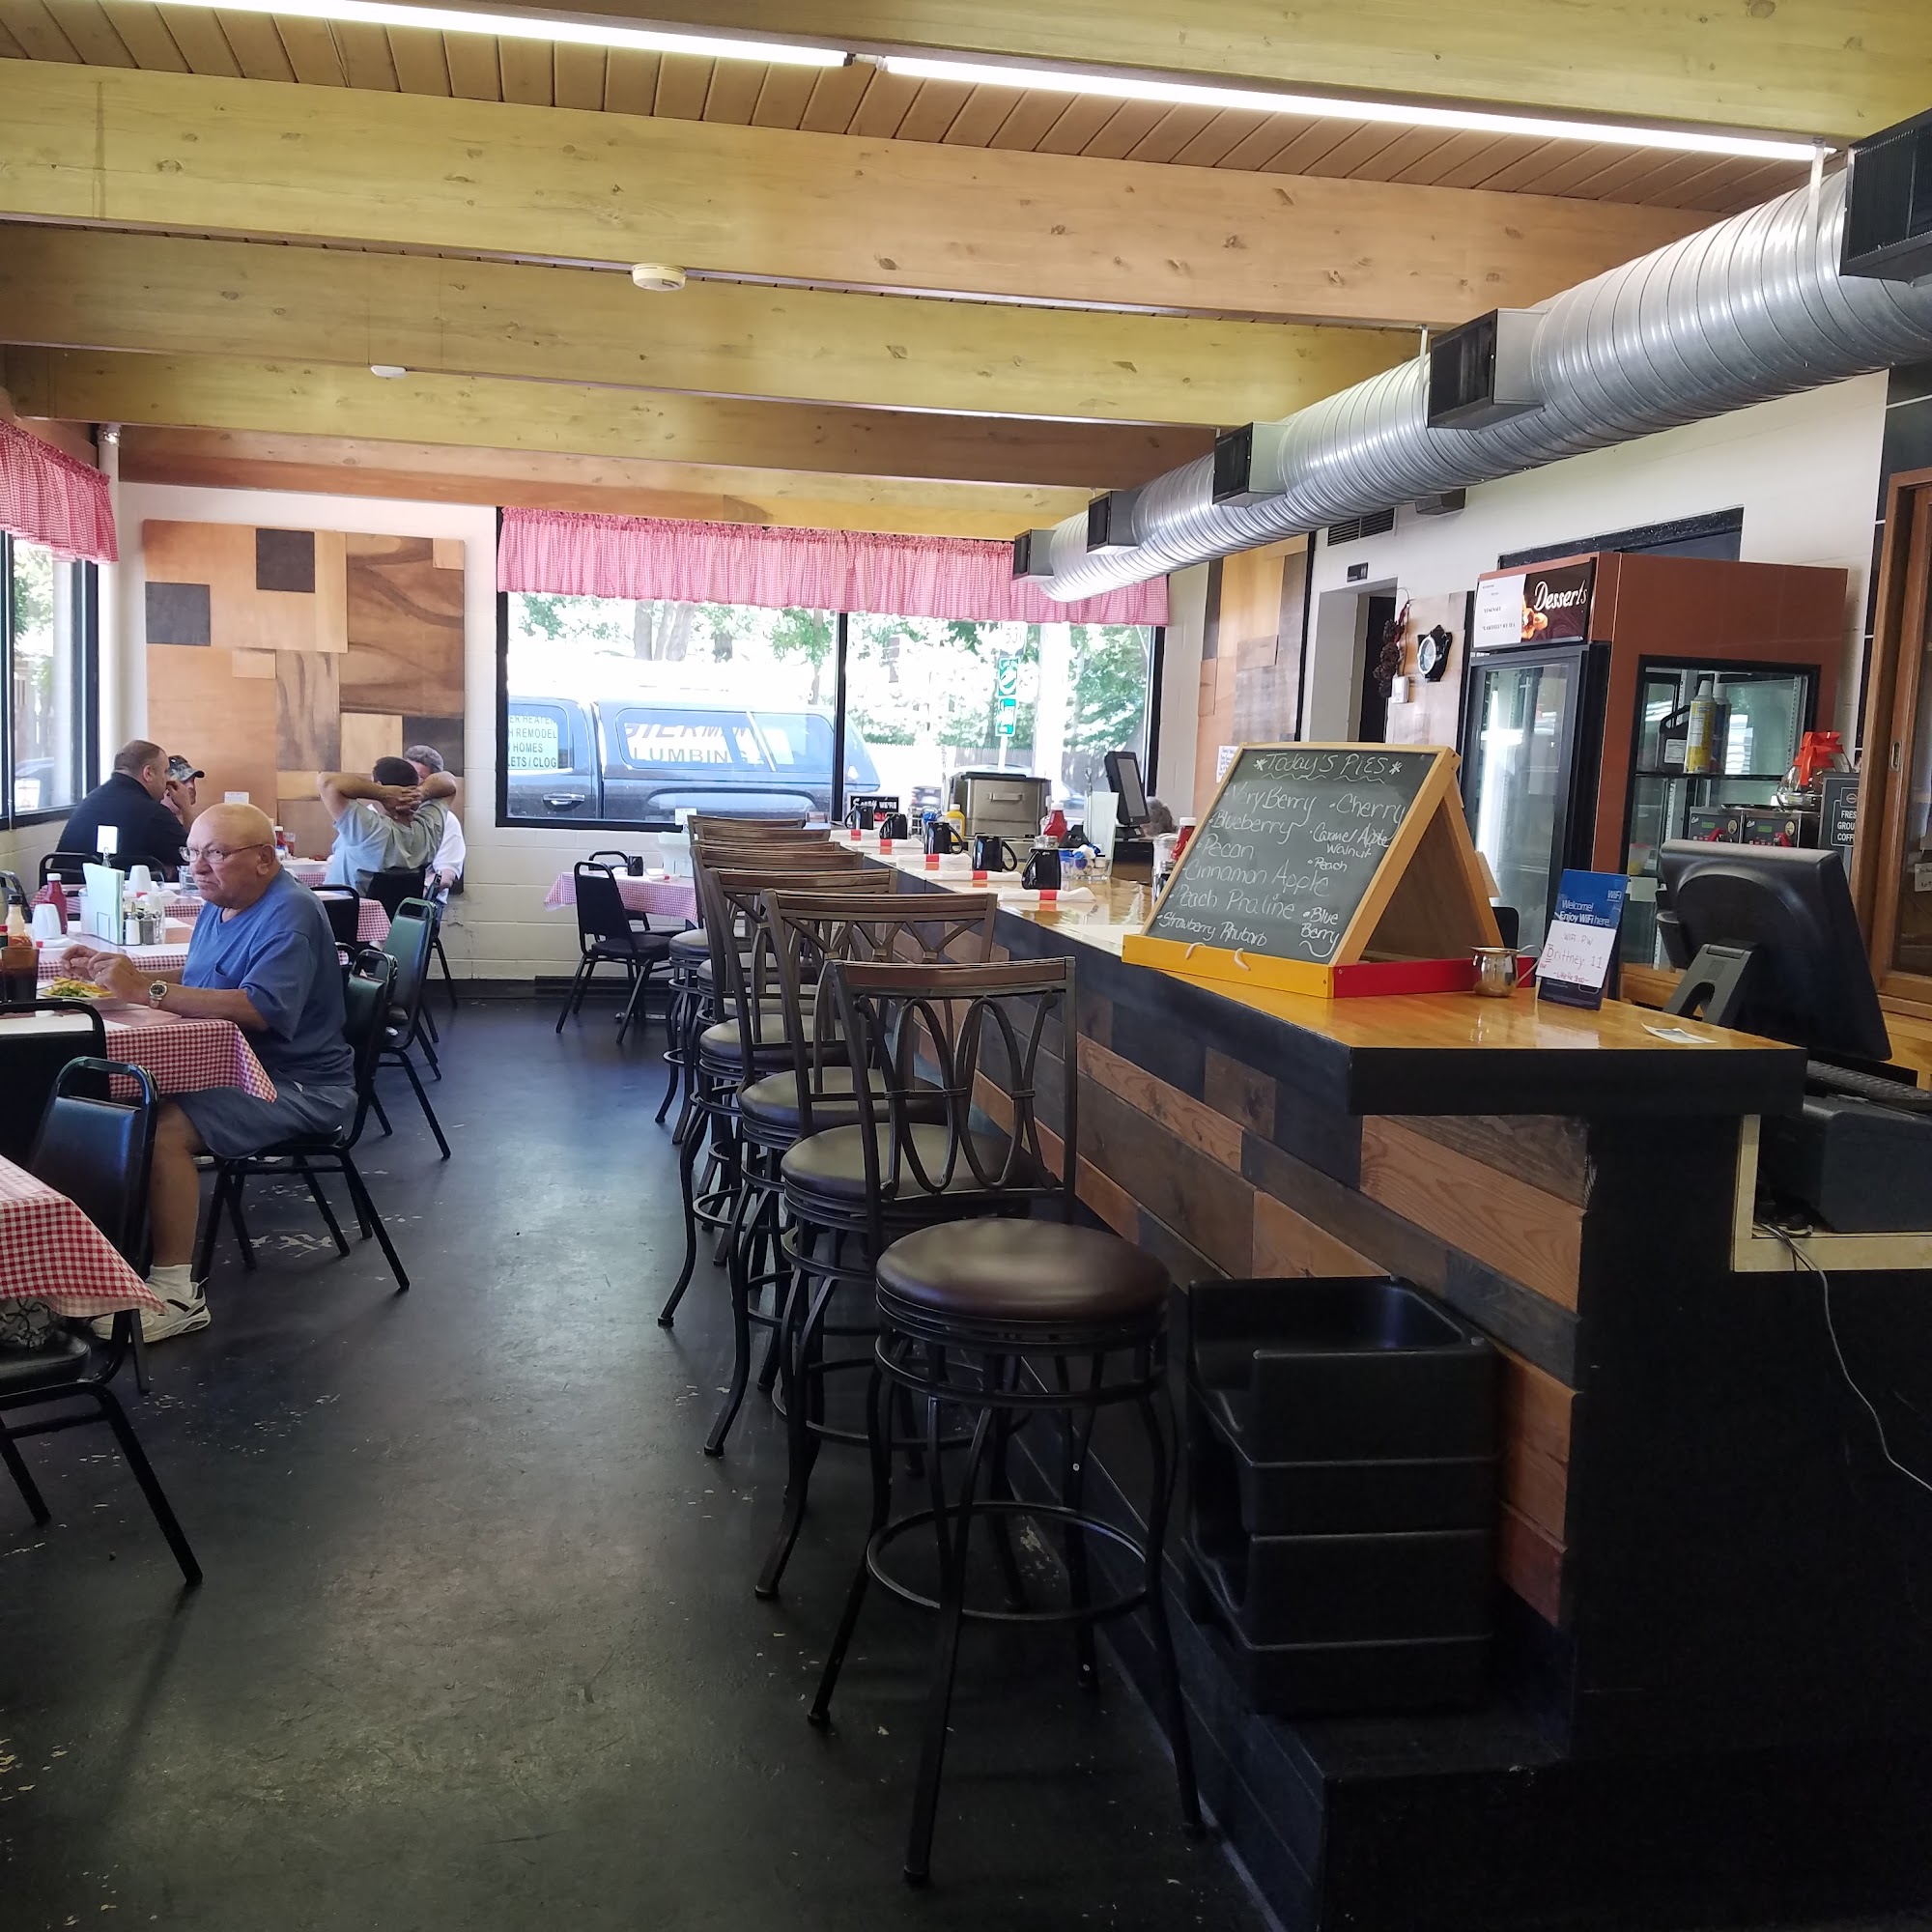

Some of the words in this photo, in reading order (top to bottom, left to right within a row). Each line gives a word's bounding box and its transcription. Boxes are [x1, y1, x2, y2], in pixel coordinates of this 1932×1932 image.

[1534, 580, 1587, 611] Desserts
[516, 727, 557, 739] REMODEL
[513, 743, 543, 753] HOMES
[1263, 786, 1317, 825] Berry
[1337, 793, 1406, 837] Cherry
[1841, 810, 1857, 819] FRES
[1210, 810, 1294, 845] Blueberry
[1837, 821, 1855, 831] GROU
[1202, 833, 1255, 861] Pecan
[1837, 833, 1855, 842] COFF
[1315, 856, 1348, 872] Peach
[1184, 859, 1267, 885] Cinnamon
[1270, 859, 1330, 897] Apple
[1179, 884, 1218, 908] Peach
[1226, 889, 1295, 920] Praline
[1562, 899, 1594, 913] Welcome!
[1310, 906, 1339, 925] Blue
[1559, 911, 1579, 923] Enjoy
[1300, 923, 1340, 950] Berry
